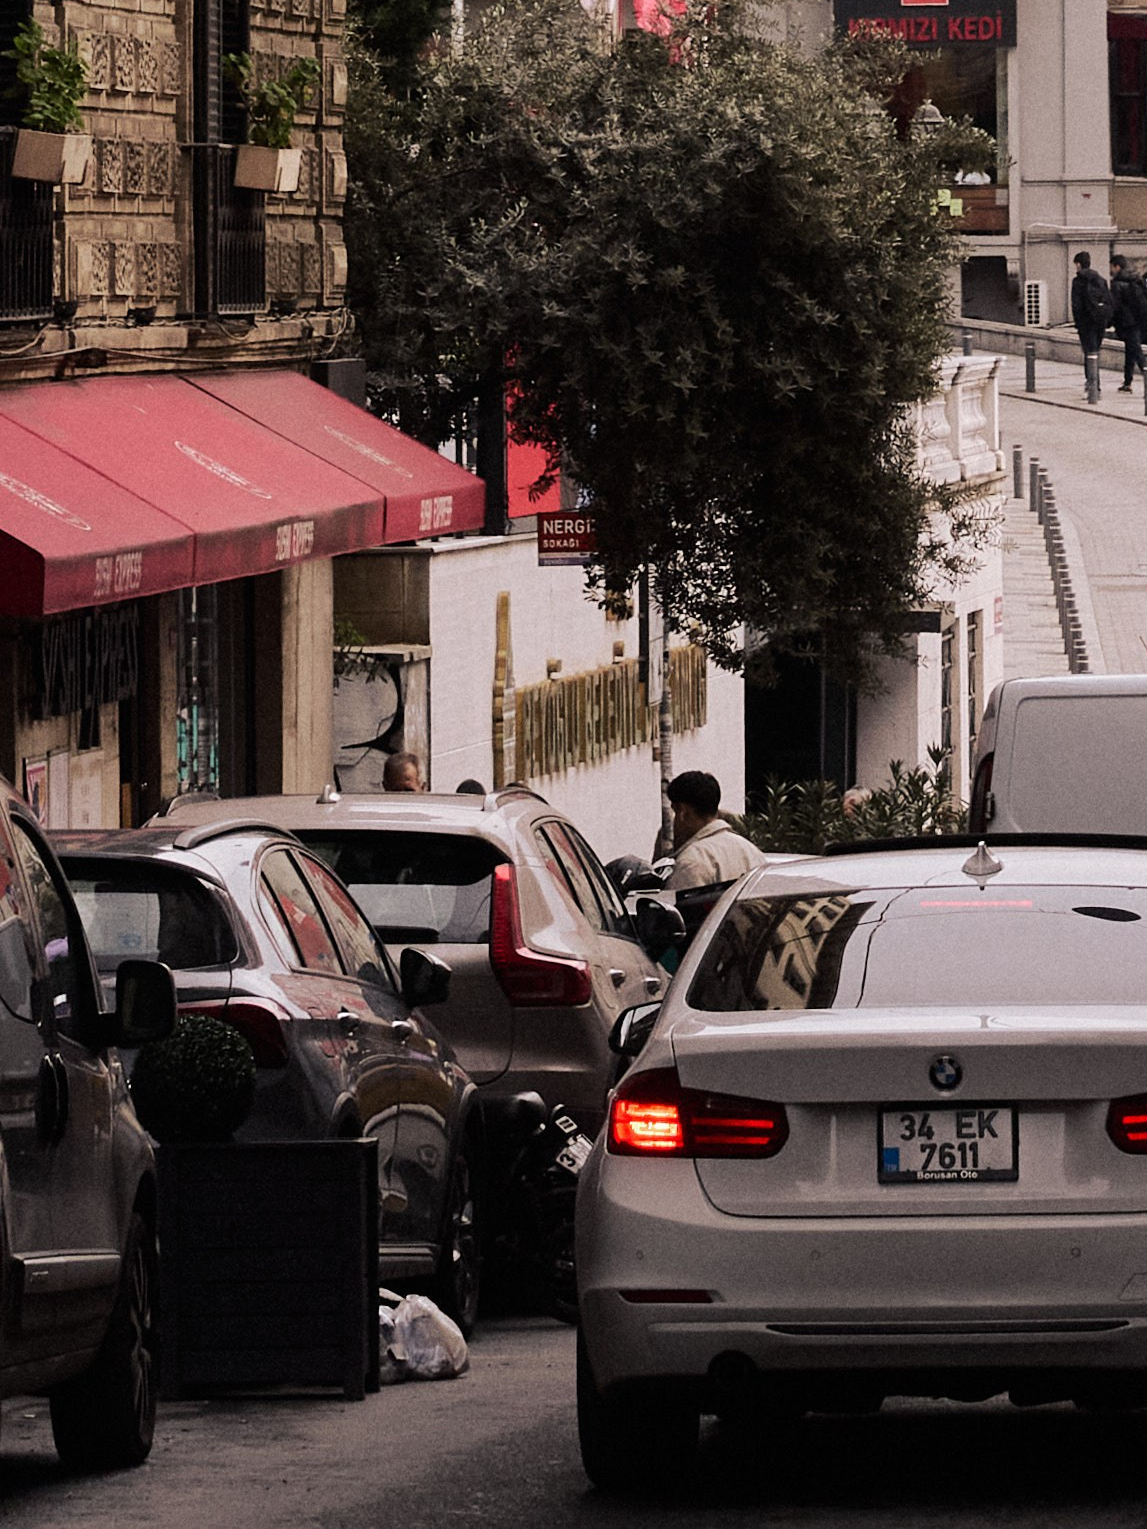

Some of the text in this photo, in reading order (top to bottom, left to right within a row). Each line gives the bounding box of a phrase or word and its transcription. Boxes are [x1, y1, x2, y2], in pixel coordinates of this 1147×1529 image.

[948, 10, 1002, 41] KEDİ
[543, 538, 580, 548] SOKAĞI
[900, 1110, 999, 1141] 34 EK
[920, 1142, 978, 1170] 7611
[917, 1170, 978, 1179] Borusan Oto
